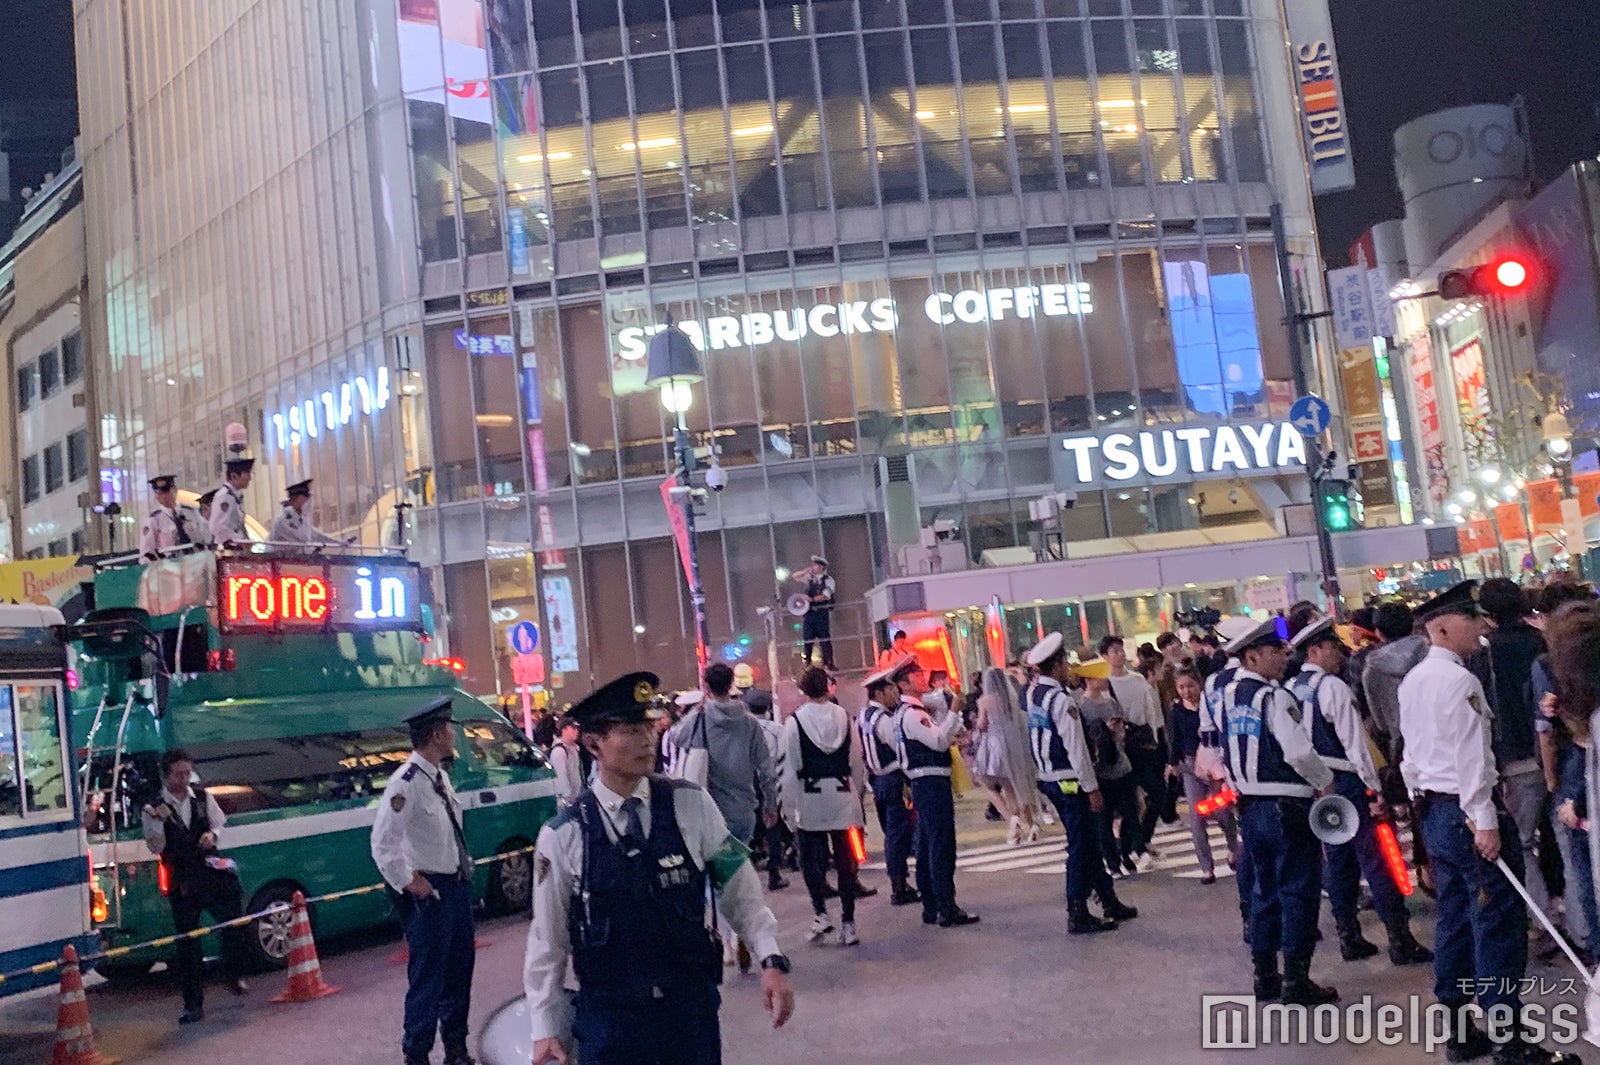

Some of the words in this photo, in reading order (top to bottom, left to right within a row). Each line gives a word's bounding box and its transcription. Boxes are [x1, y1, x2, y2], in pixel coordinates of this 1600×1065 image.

[1296, 39, 1347, 164] SEIBU
[924, 281, 1094, 325] COFFEE
[1346, 273, 1368, 339] 渋谷駅前
[1062, 422, 1307, 483] TSUTAYA
[227, 576, 327, 620] rone
[354, 567, 406, 619] in
